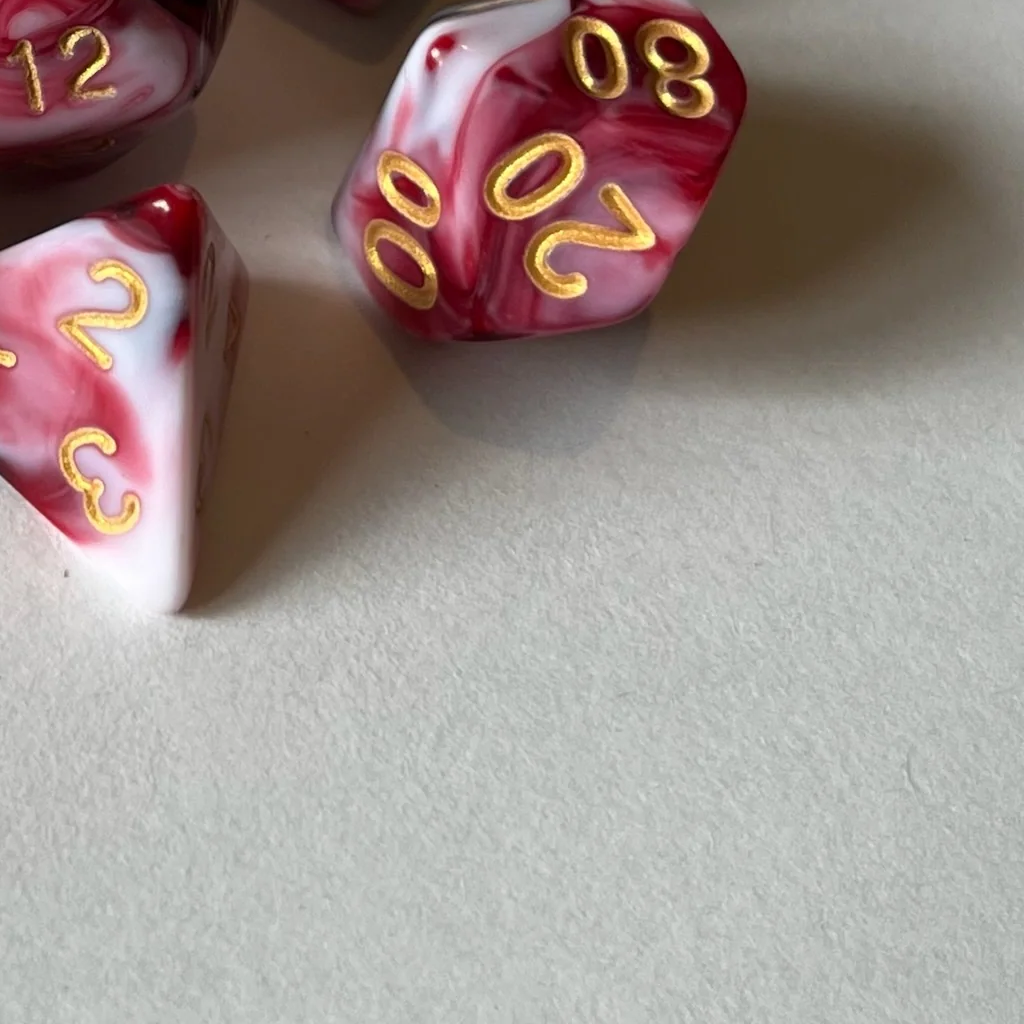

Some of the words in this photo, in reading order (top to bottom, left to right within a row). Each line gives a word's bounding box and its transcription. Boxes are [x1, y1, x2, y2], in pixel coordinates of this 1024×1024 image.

[6, 25, 117, 115] 12
[364, 150, 441, 310] 00
[484, 133, 656, 299] 20
[56, 258, 149, 370] 2
[58, 427, 140, 536] 3
